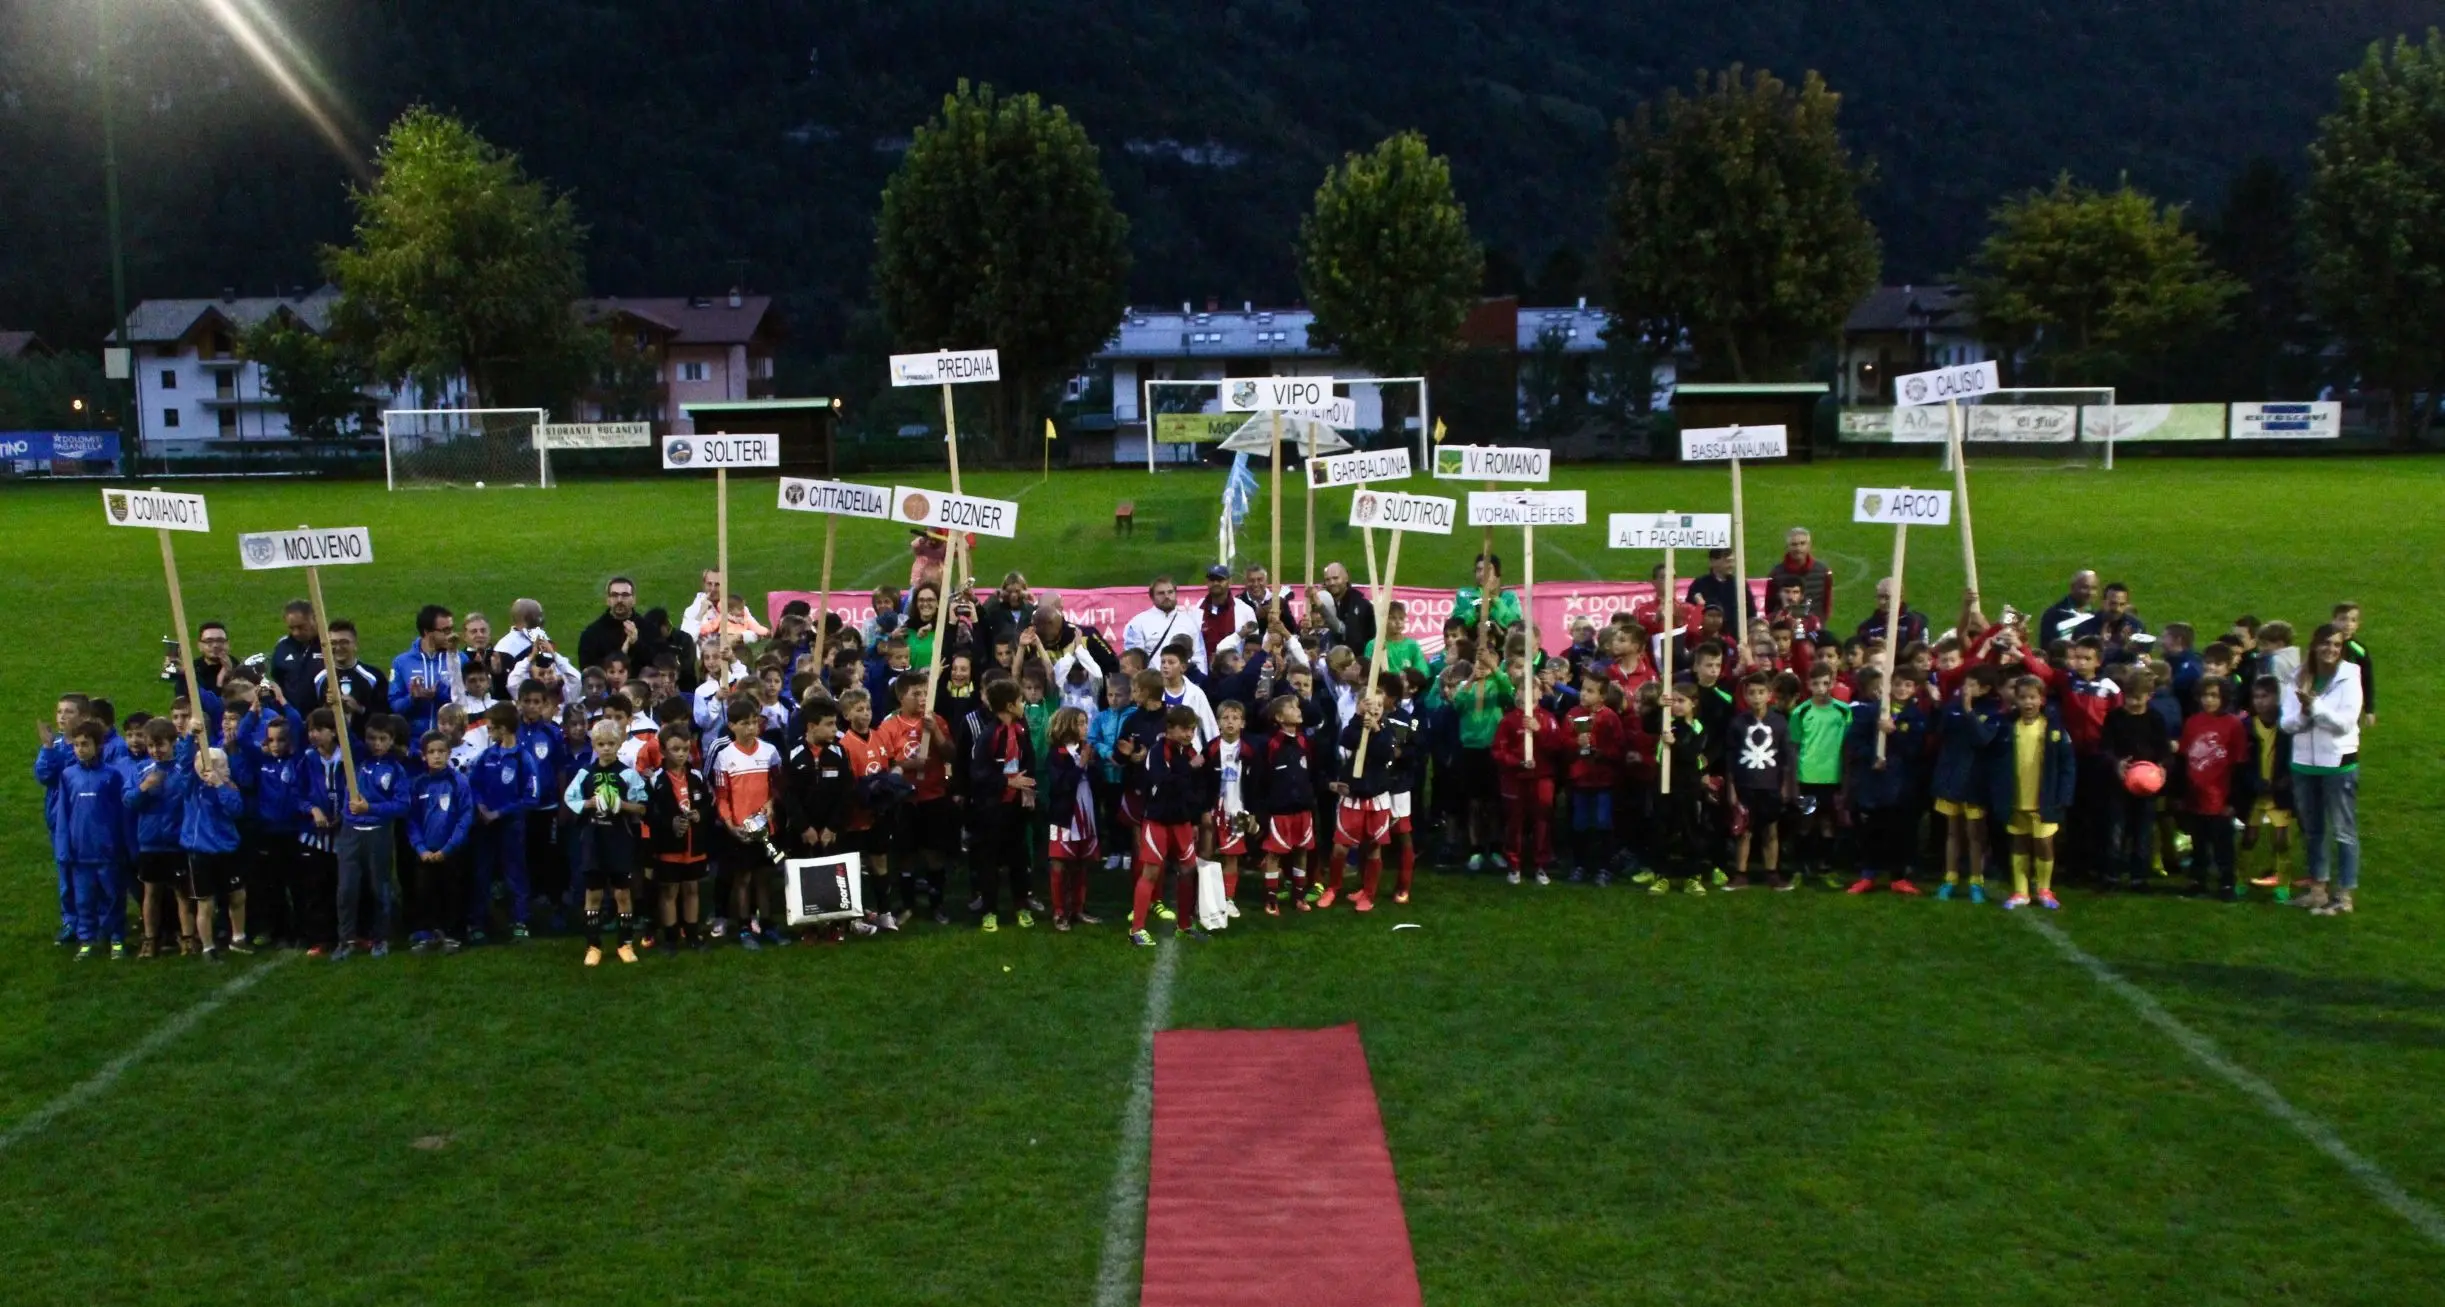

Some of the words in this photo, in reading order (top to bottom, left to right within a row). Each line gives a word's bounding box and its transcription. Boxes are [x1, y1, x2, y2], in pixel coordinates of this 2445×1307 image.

[937, 356, 994, 379] PREDAIA
[1936, 369, 1985, 396] CALISIO
[1272, 383, 1320, 406] VIPO
[704, 440, 767, 462] SOLTERI
[1691, 442, 1727, 459] BASSA
[1731, 441, 1782, 457] ANAUNIA
[1332, 455, 1409, 482] GARIBALDINA
[1469, 451, 1481, 473] V.
[1485, 452, 1542, 475] ROMANO
[133, 496, 188, 523] COMANO
[188, 500, 203, 524] T.
[809, 486, 883, 513] CITTADELLA
[1890, 494, 1940, 517] ARCO
[940, 500, 1002, 530] BOZNER
[1475, 507, 1520, 523] VORAN
[1523, 507, 1574, 523] LEIFERS
[283, 534, 362, 561] MOLVENO
[1650, 530, 1728, 547] PAGANELLA
